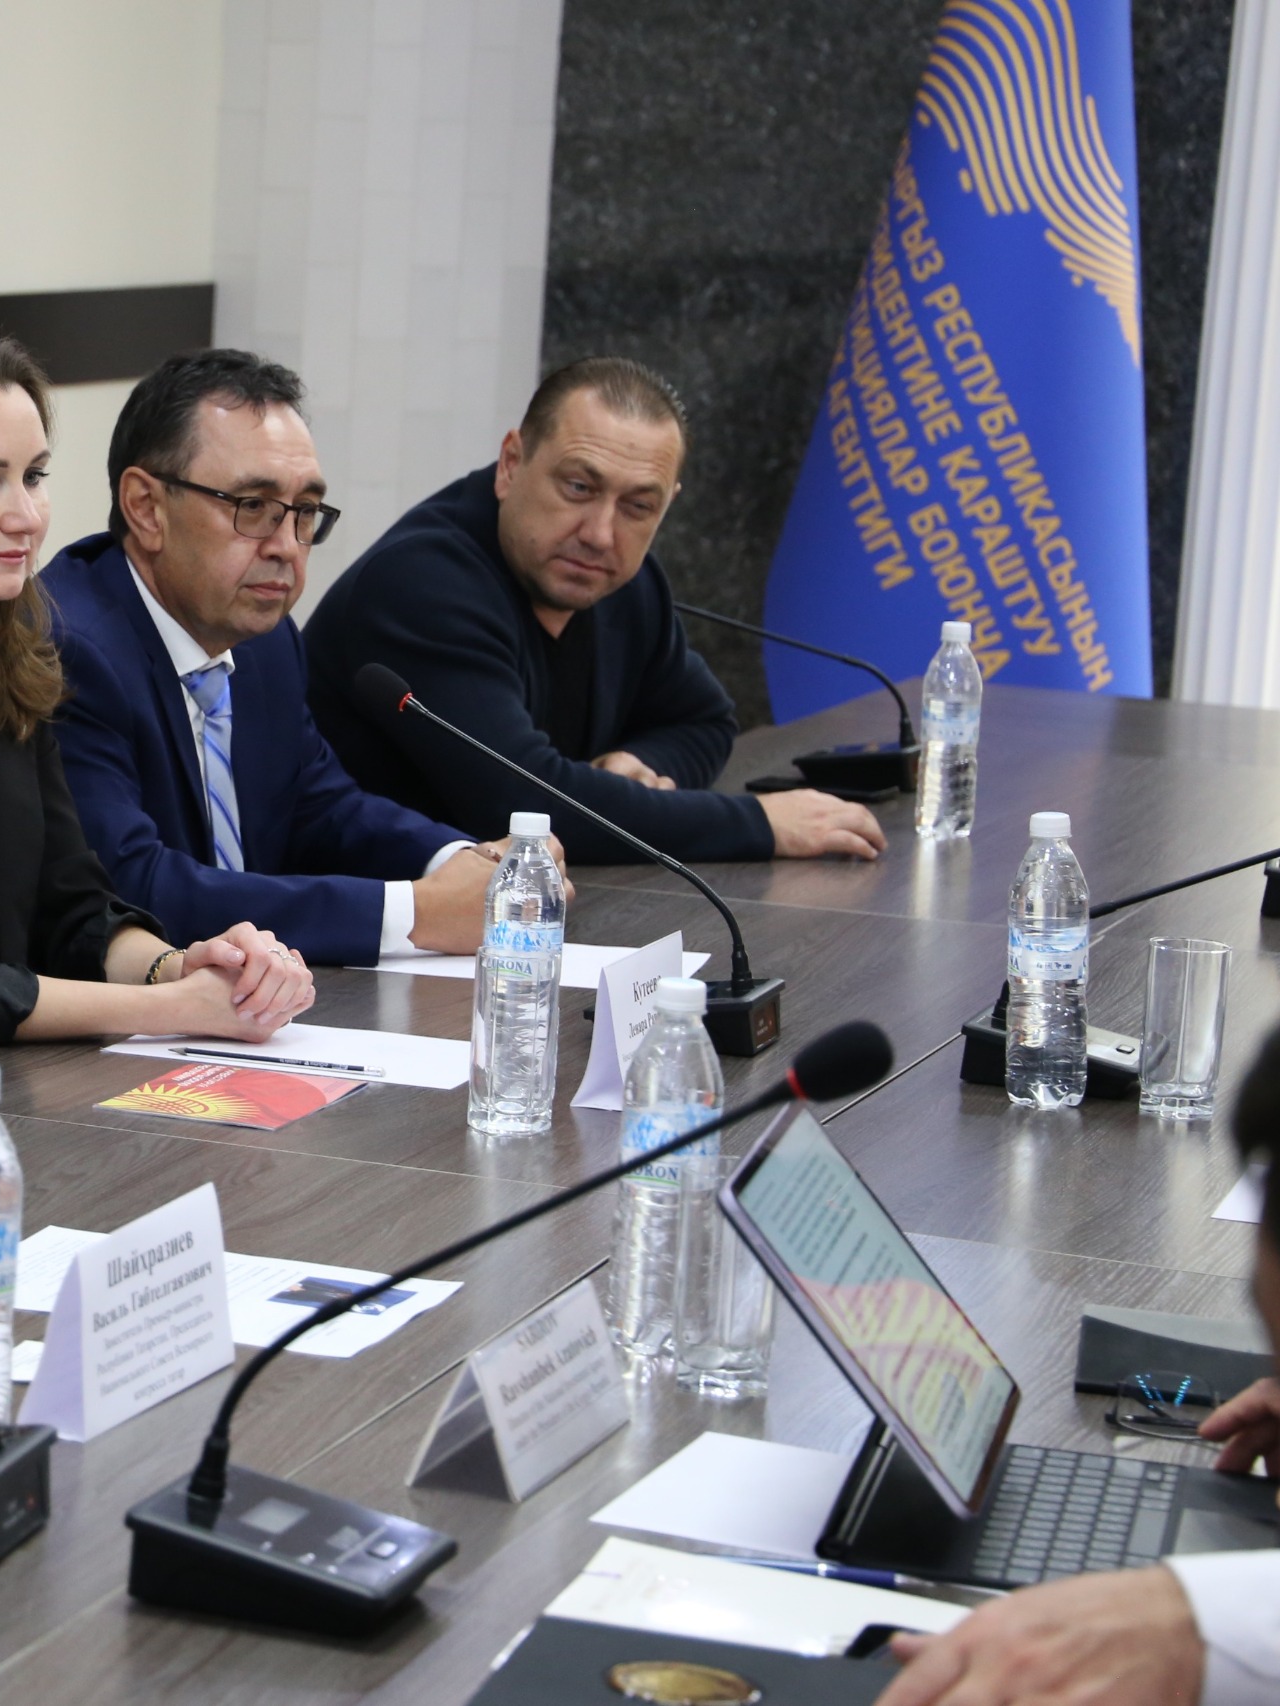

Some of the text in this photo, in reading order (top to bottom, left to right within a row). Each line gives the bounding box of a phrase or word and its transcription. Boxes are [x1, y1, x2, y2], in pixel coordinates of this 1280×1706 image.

[829, 378, 915, 590] АГЕНТТИГИ
[923, 284, 1113, 692] РЕСПУБЛИКАСЫНЫН
[939, 445, 1062, 656] КАРАШТУУ
[908, 503, 1011, 682] БОЮНЧА
[107, 1230, 194, 1289] Шайхразиев
[634, 1164, 679, 1180] ORON
